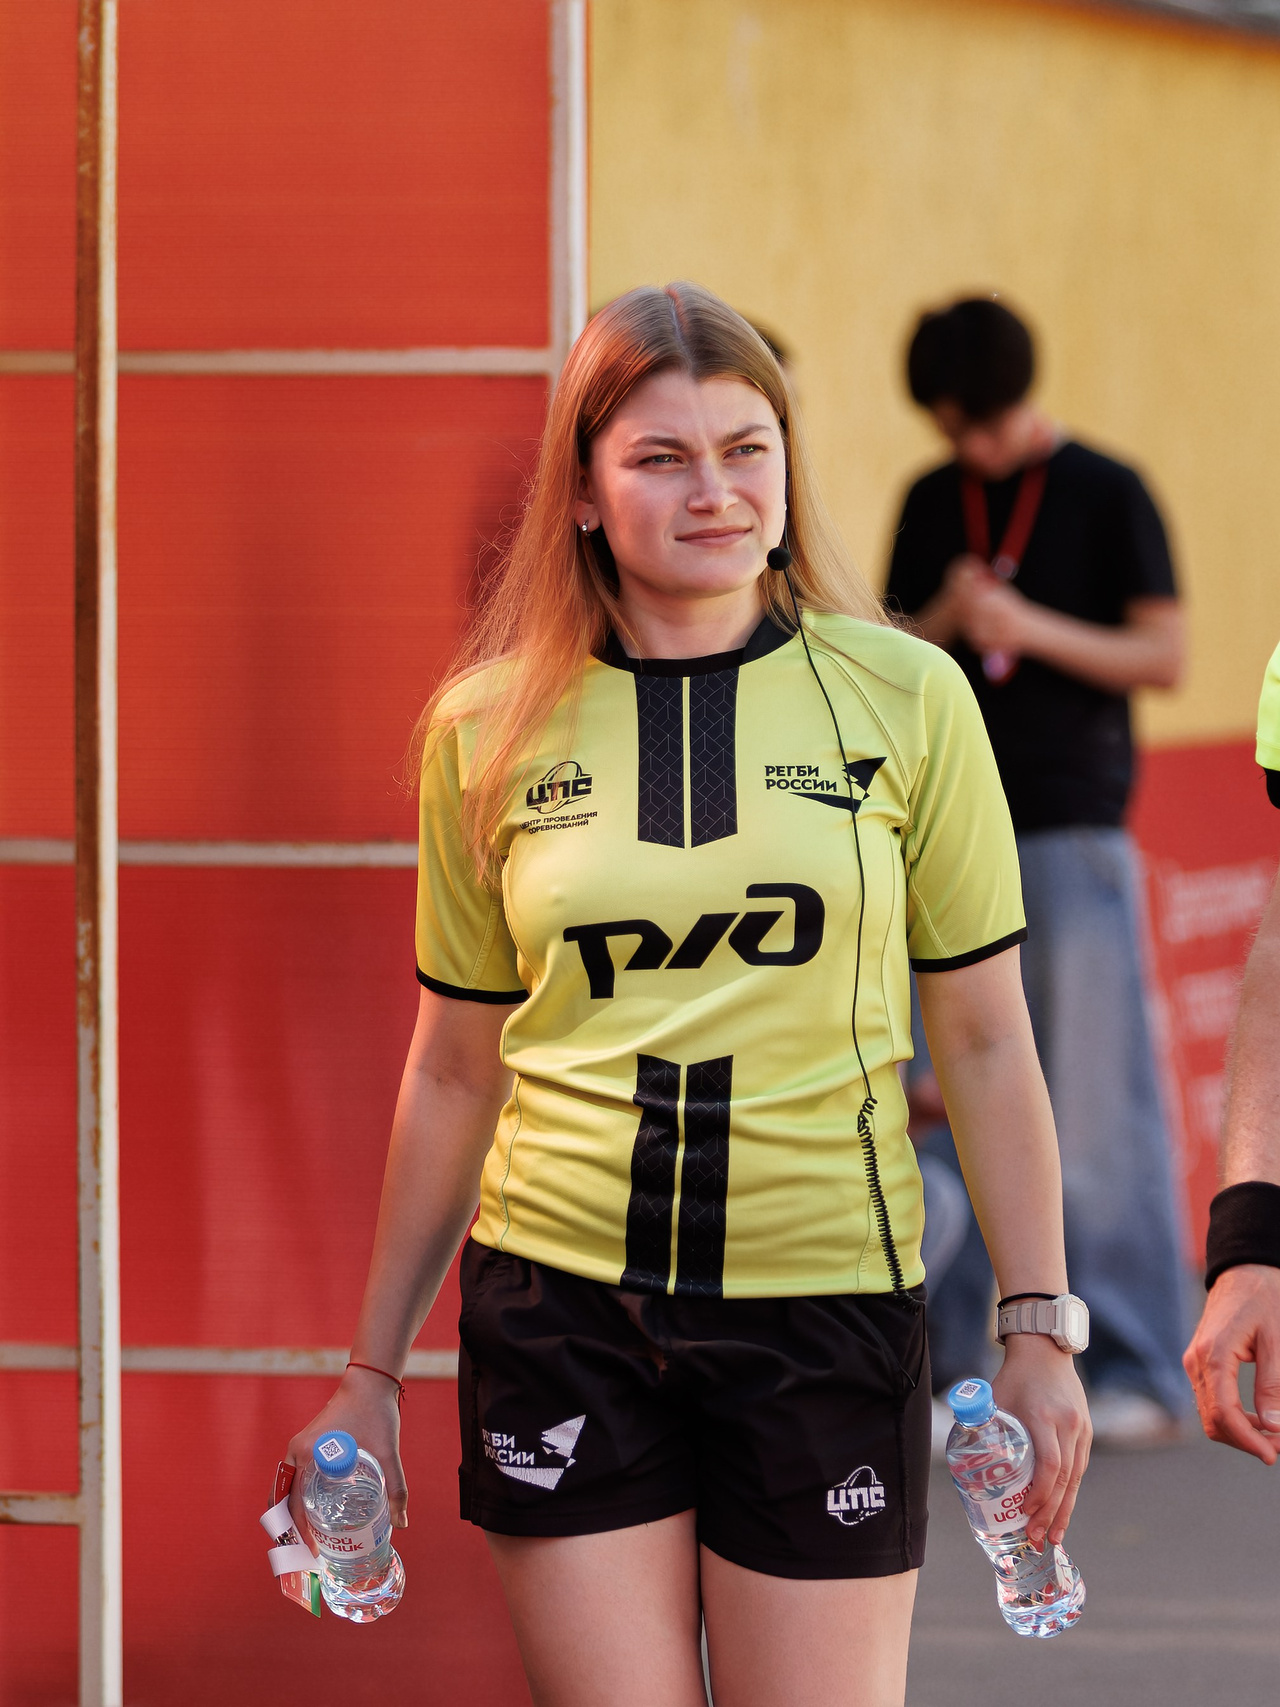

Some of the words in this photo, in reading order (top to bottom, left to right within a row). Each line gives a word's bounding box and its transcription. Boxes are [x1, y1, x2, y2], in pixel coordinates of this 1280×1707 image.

[764, 765, 820, 777] РЕГБИ
[525, 776, 593, 807] ЦПС
[765, 778, 838, 793] РОССИИ
[543, 811, 598, 823] ПРОВЕДЕНИЯ
[528, 819, 589, 835] СОРЕВНОВАНИЙ
[827, 1485, 886, 1511] ЦПС
[1001, 1480, 1033, 1509] СВЯТ
[312, 1527, 353, 1545] ЯТОЙ
[313, 1533, 365, 1552] ОЧНИК
